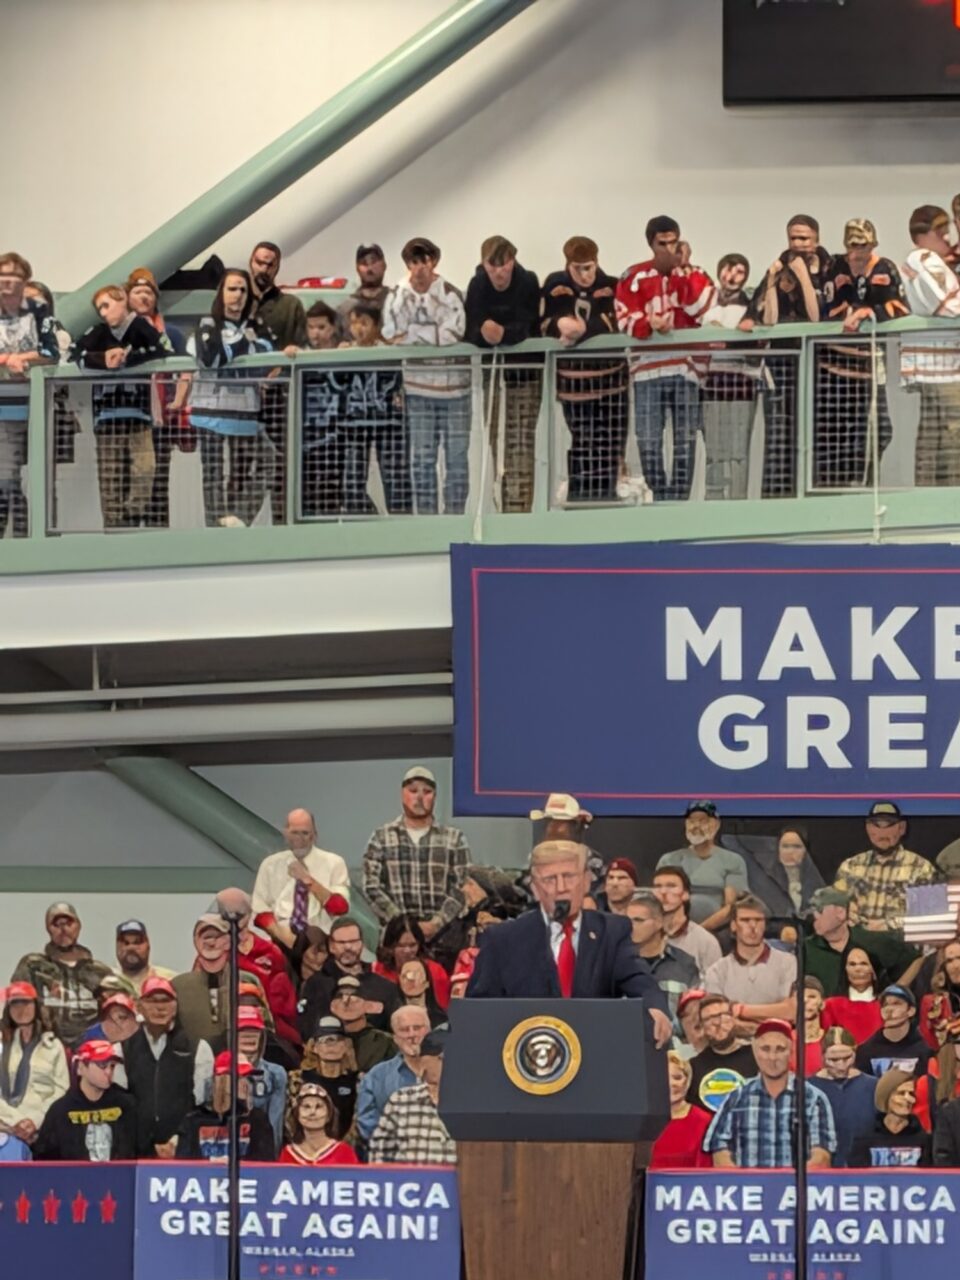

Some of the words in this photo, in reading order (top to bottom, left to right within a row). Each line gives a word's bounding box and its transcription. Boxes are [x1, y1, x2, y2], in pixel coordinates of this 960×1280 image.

[149, 1177, 258, 1204] MAKE
[271, 1179, 450, 1209] AMERICA
[655, 1184, 763, 1212] MAKE
[778, 1184, 957, 1212] AMERICA
[160, 1209, 288, 1238] GREAT
[302, 1212, 439, 1241] AGAIN!
[666, 1218, 795, 1244] GREAT
[807, 1218, 945, 1244] AGAIN!
